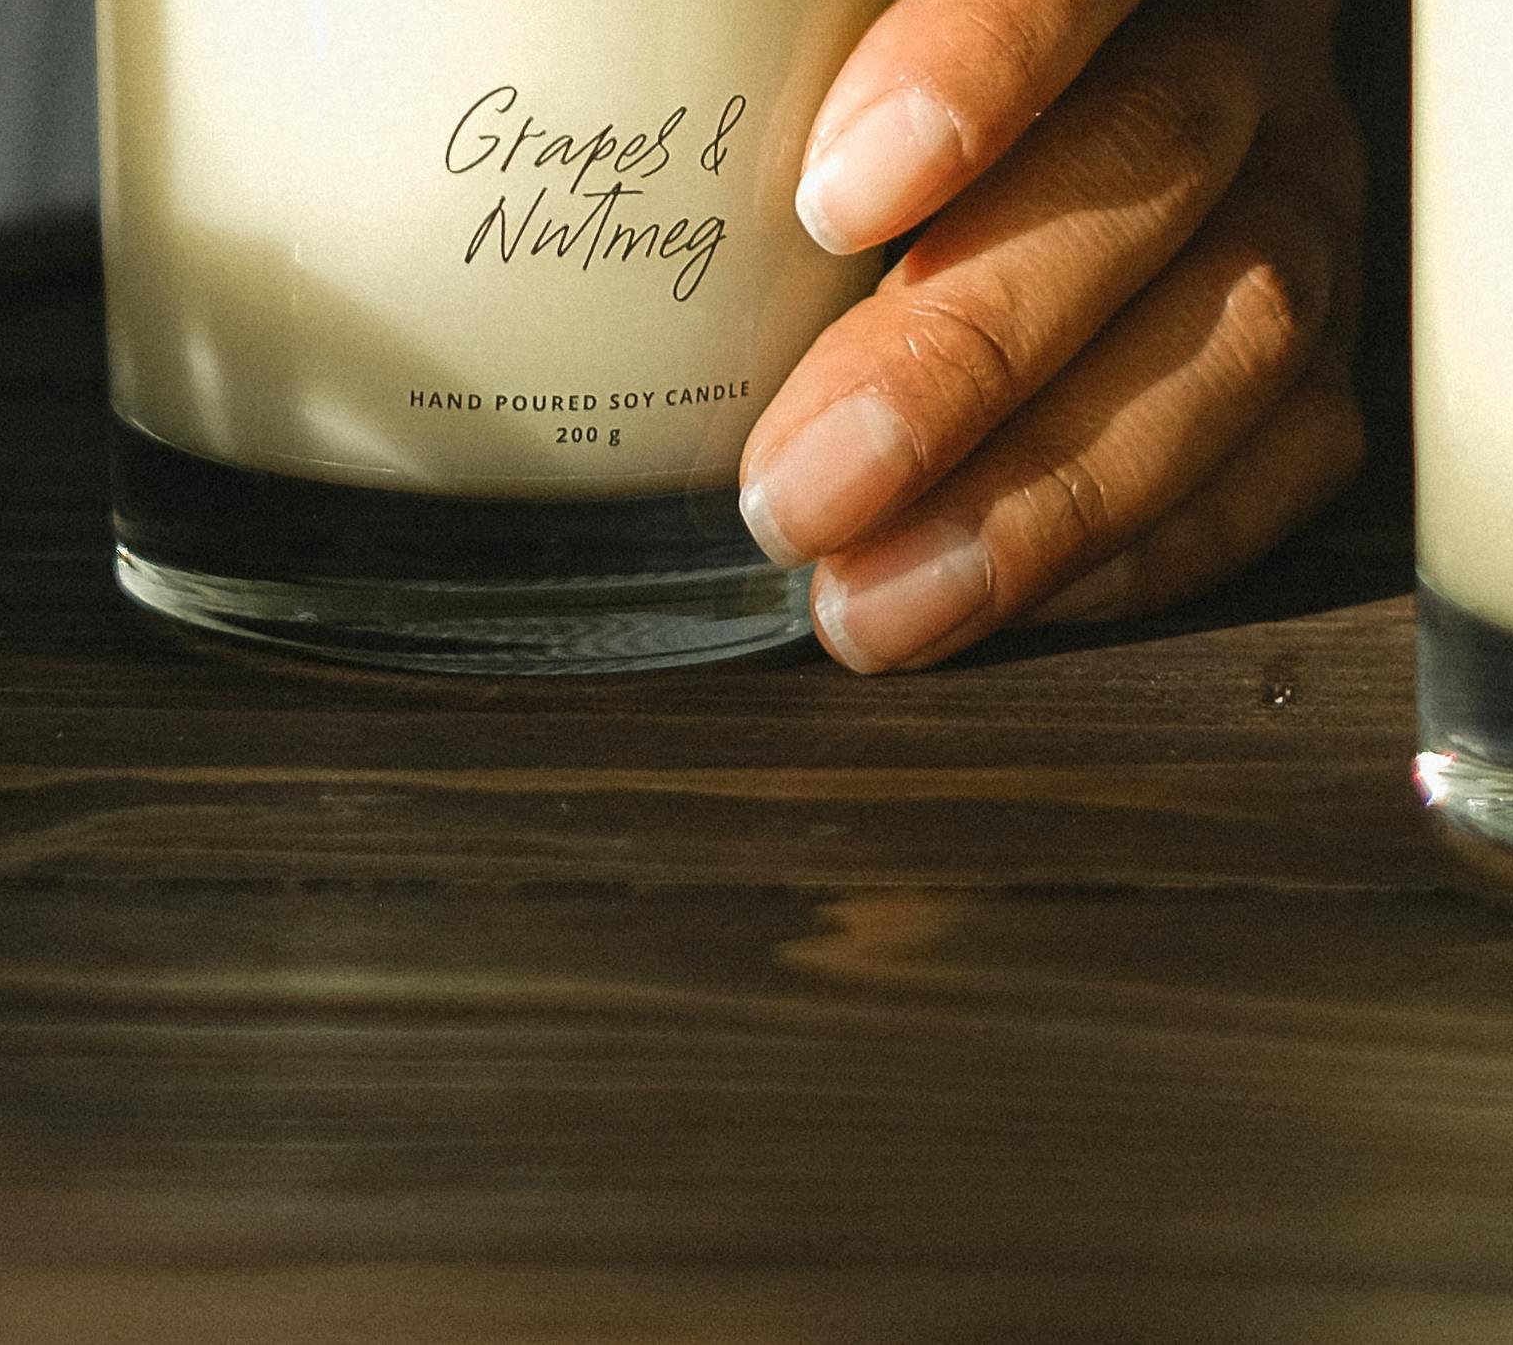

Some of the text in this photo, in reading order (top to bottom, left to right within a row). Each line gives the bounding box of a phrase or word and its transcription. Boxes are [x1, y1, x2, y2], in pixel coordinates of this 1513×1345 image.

[445, 85, 748, 195] Grapes &
[464, 180, 728, 303] Nutmeg
[409, 379, 750, 412] HAND POURED SOY CANDLE
[555, 426, 621, 447] 200 g
